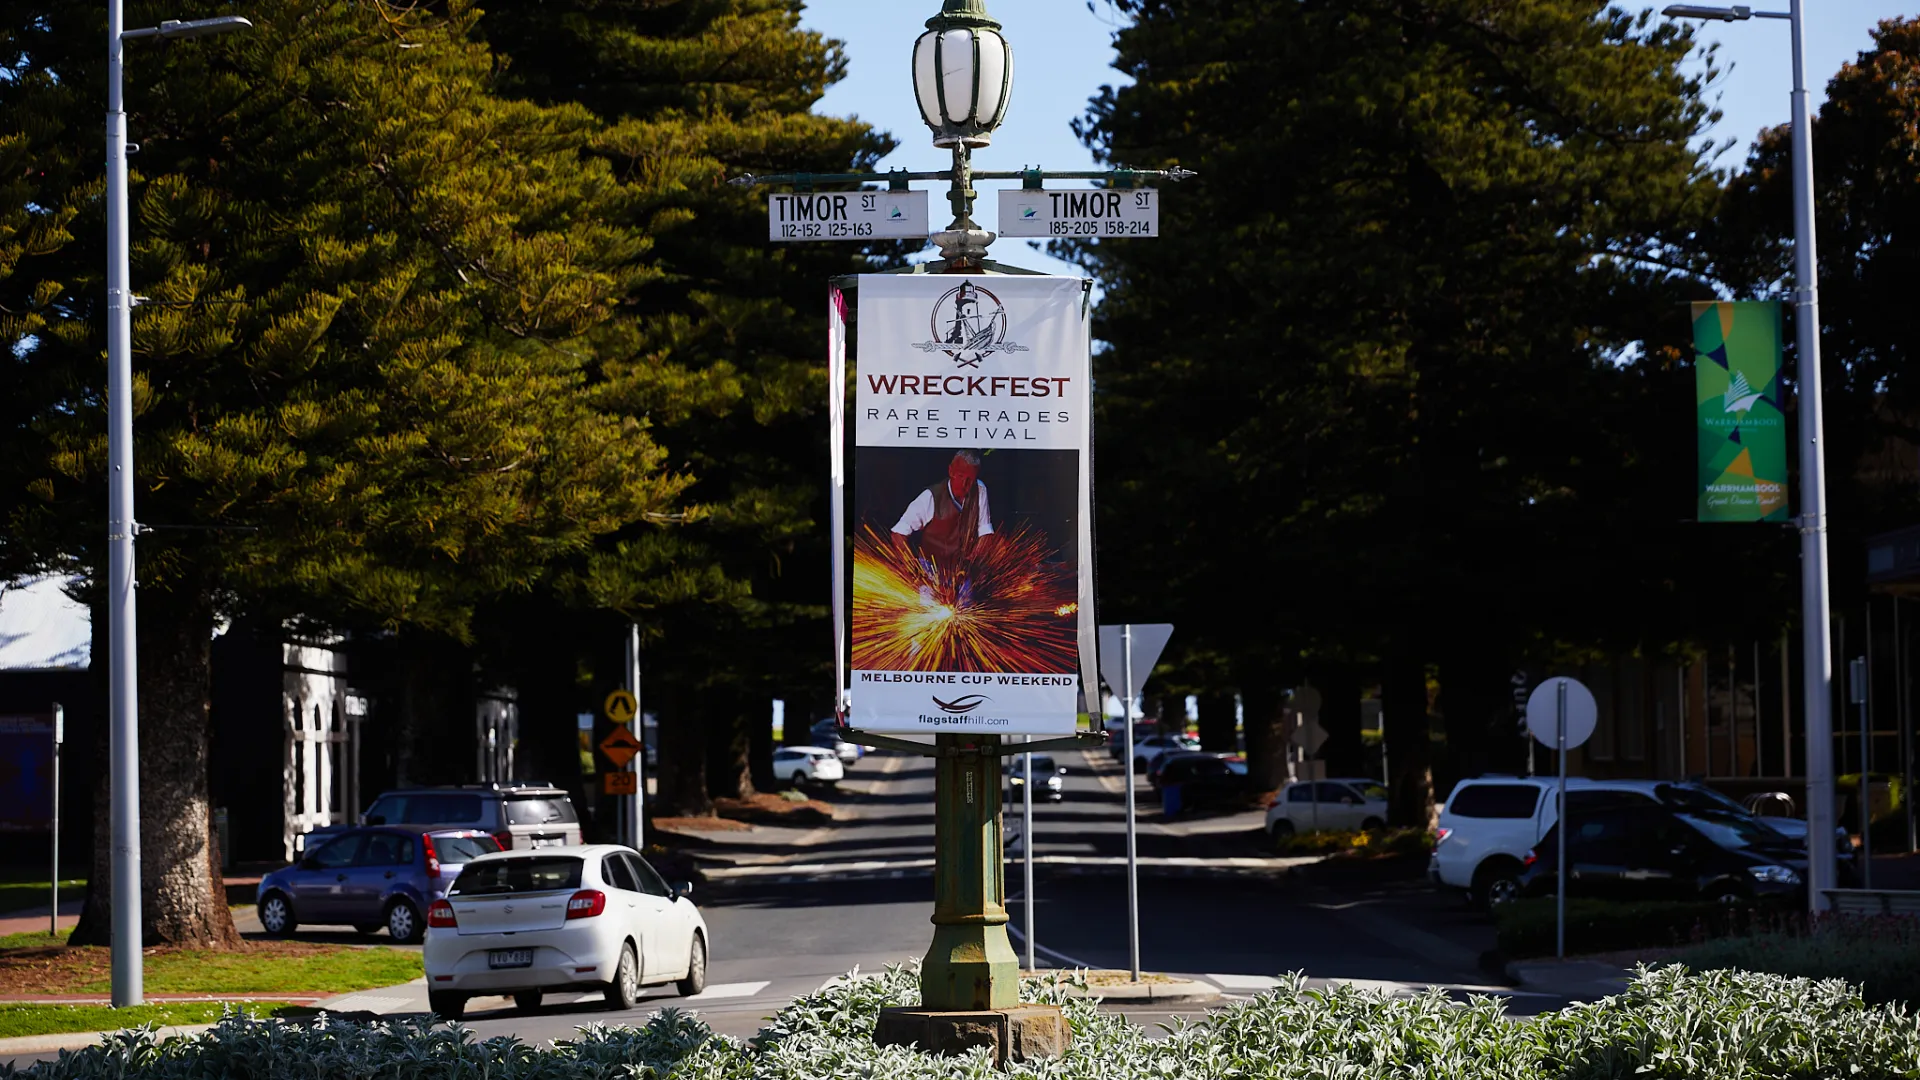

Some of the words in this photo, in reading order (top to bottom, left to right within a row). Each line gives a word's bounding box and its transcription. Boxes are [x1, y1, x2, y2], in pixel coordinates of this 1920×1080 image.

[776, 196, 847, 222] TIMOR
[861, 195, 876, 209] ST
[1049, 192, 1121, 218] TIMOR
[1136, 192, 1150, 207] ST
[781, 224, 821, 238] 112-152
[829, 223, 872, 237] 125-163
[1050, 221, 1098, 235] 185-205
[1105, 221, 1150, 235] 158-214
[867, 374, 1070, 397] WRECKFEST
[867, 408, 940, 422] RARE
[958, 409, 1070, 423] TRADES
[897, 426, 1037, 440] FESTIVAL
[1705, 484, 1781, 493] WARRNAMBOOL
[861, 673, 956, 684] MELBOURNE
[961, 675, 992, 685] CUP
[997, 676, 1073, 686] WEEKEND
[918, 714, 1009, 726] flagstaffhill.com
[612, 773, 630, 786] 20
